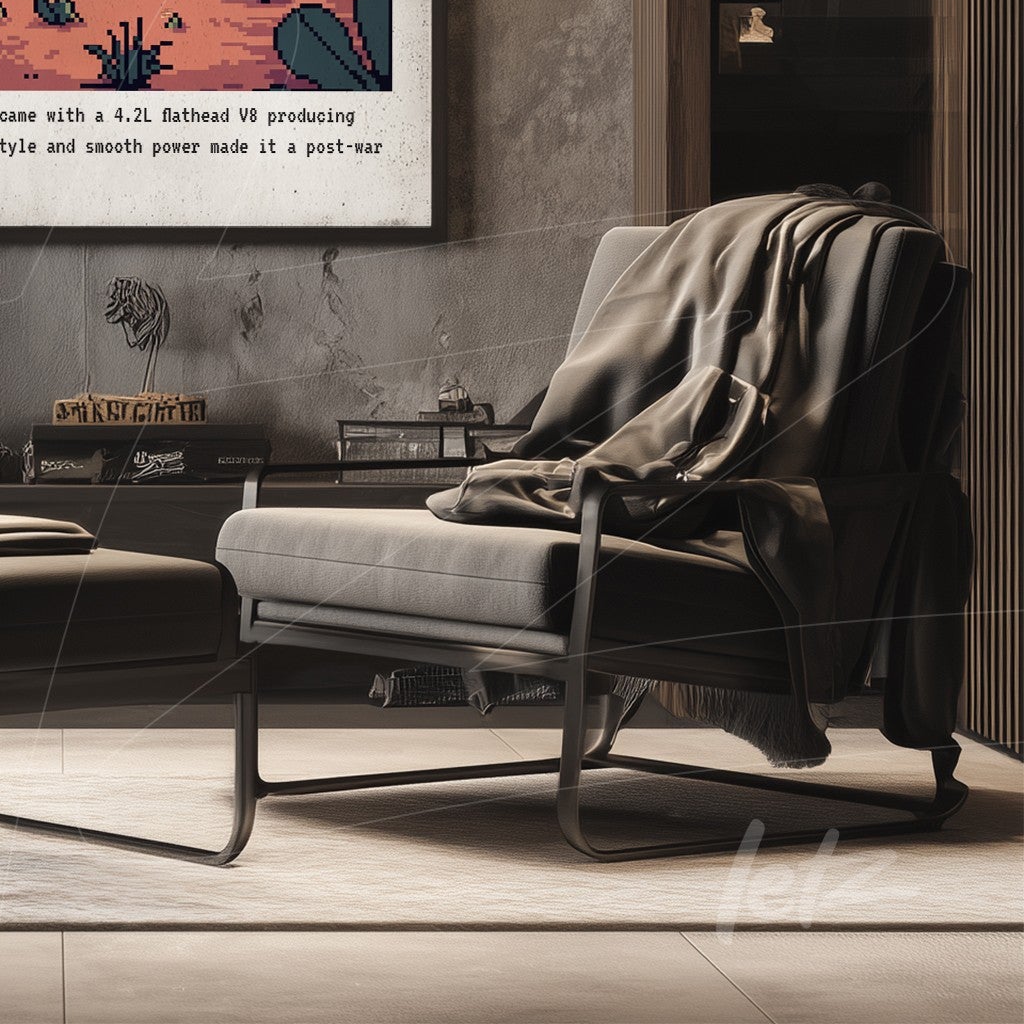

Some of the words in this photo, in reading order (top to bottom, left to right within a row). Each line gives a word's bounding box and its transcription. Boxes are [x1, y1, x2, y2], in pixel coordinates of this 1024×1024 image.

[46, 107, 85, 123] with
[94, 111, 104, 123] a
[114, 107, 152, 123] 4.2L
[162, 107, 229, 123] flathead
[239, 107, 257, 123] V8
[268, 107, 356, 127] producing
[46, 138, 75, 154] and
[85, 138, 143, 154] smooth
[152, 142, 200, 158] power
[210, 138, 248, 154] made
[259, 138, 276, 154] it
[287, 142, 297, 154] a
[306, 138, 383, 158] post-war
